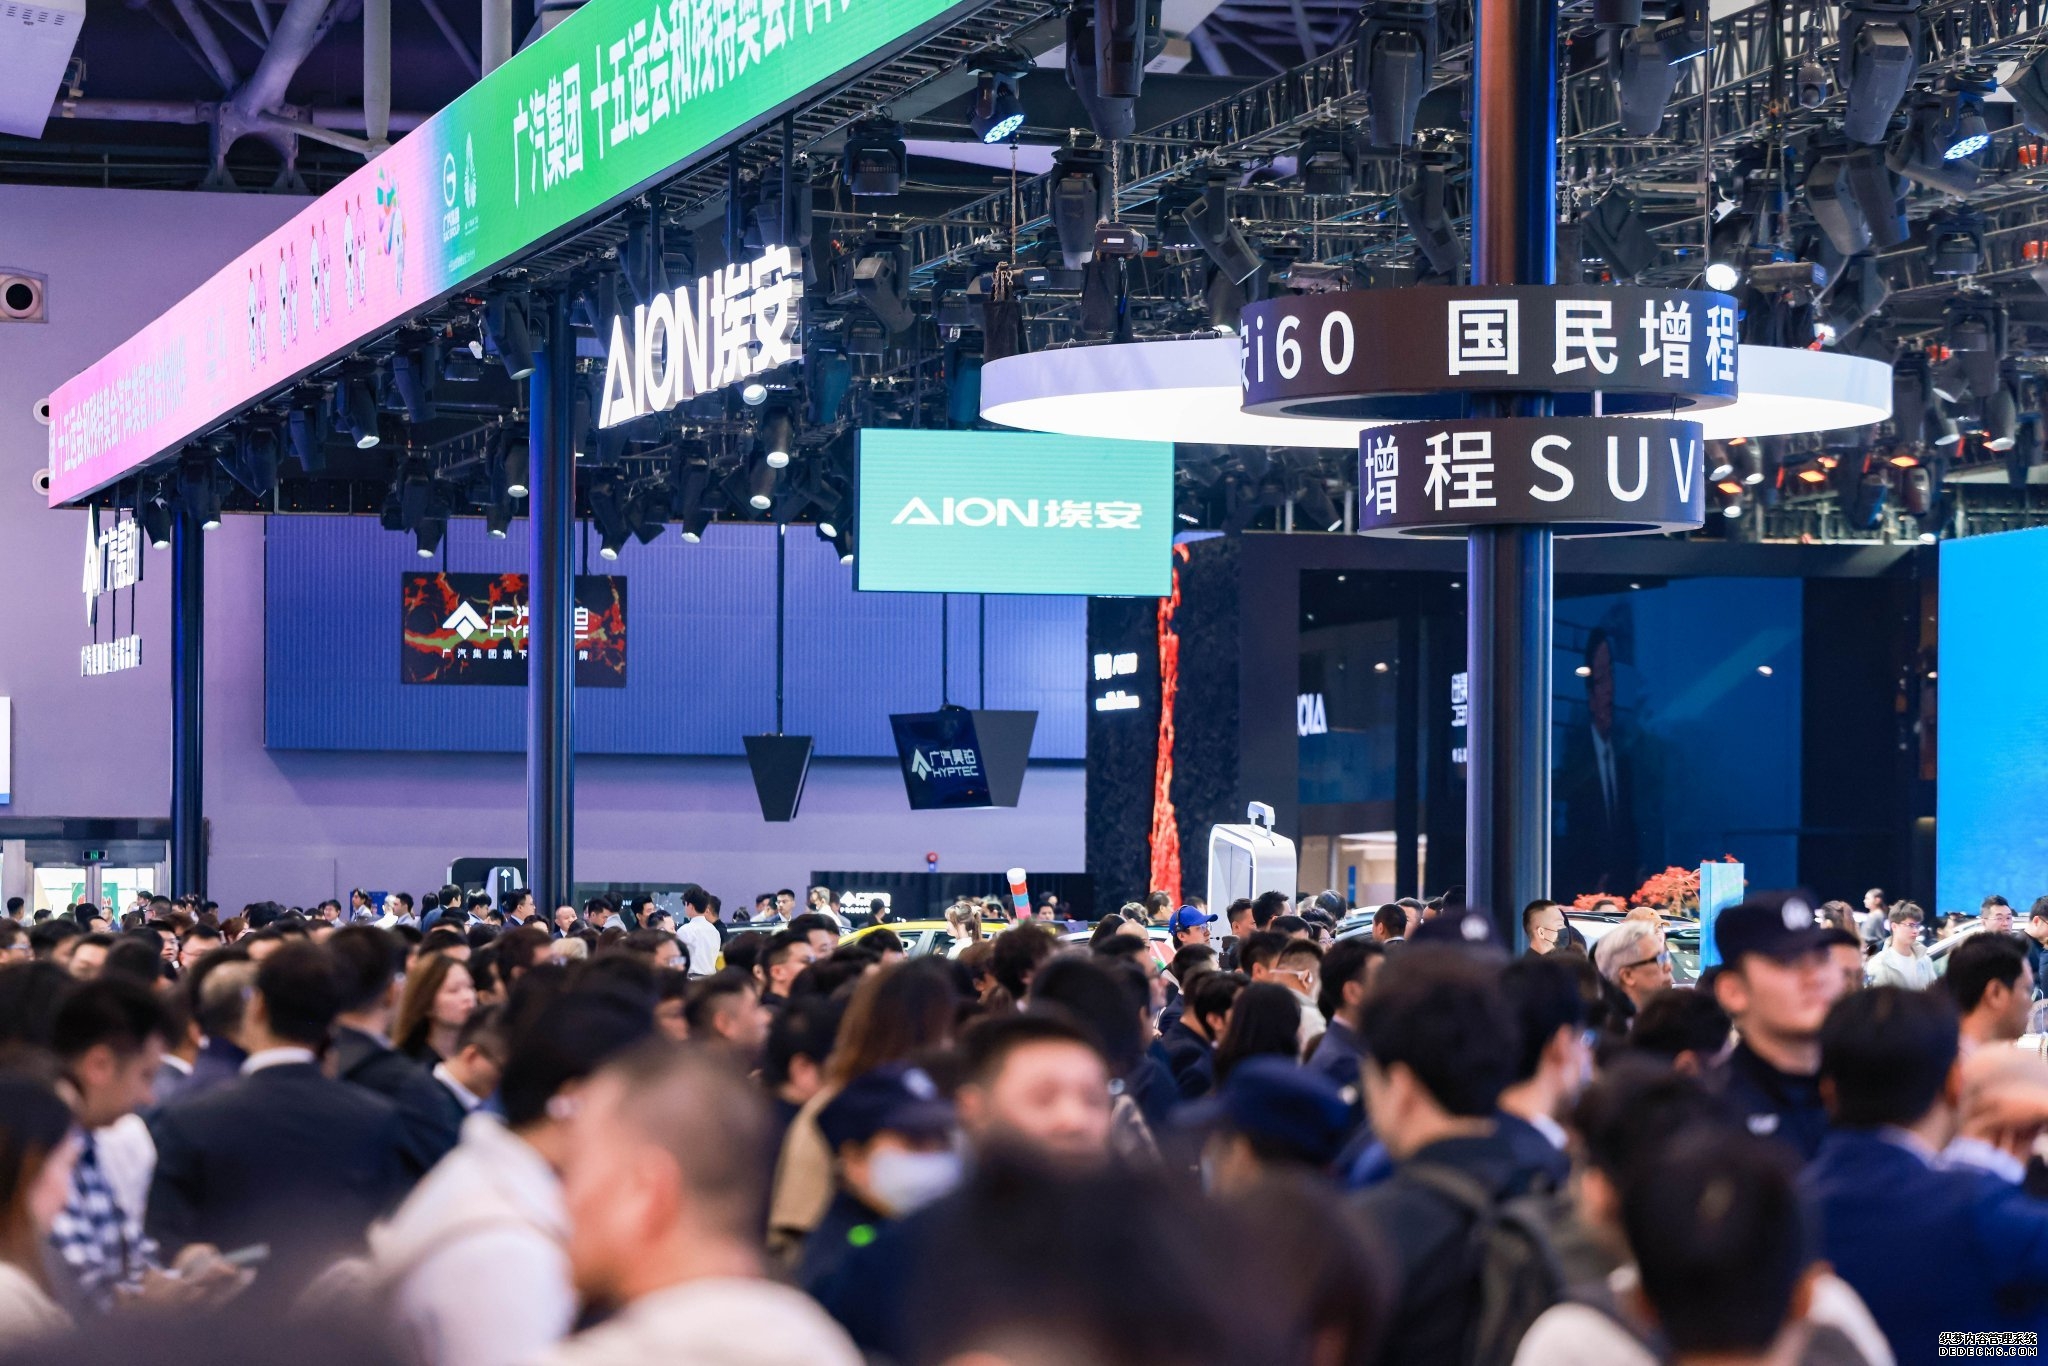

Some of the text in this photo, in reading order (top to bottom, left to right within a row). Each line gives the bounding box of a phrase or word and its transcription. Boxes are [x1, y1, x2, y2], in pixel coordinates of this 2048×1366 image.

[512, 0, 852, 209] 广汽集团 十五运会和残特奥
[1448, 299, 1735, 382] 国民增程
[932, 765, 980, 778] HYPTEC
